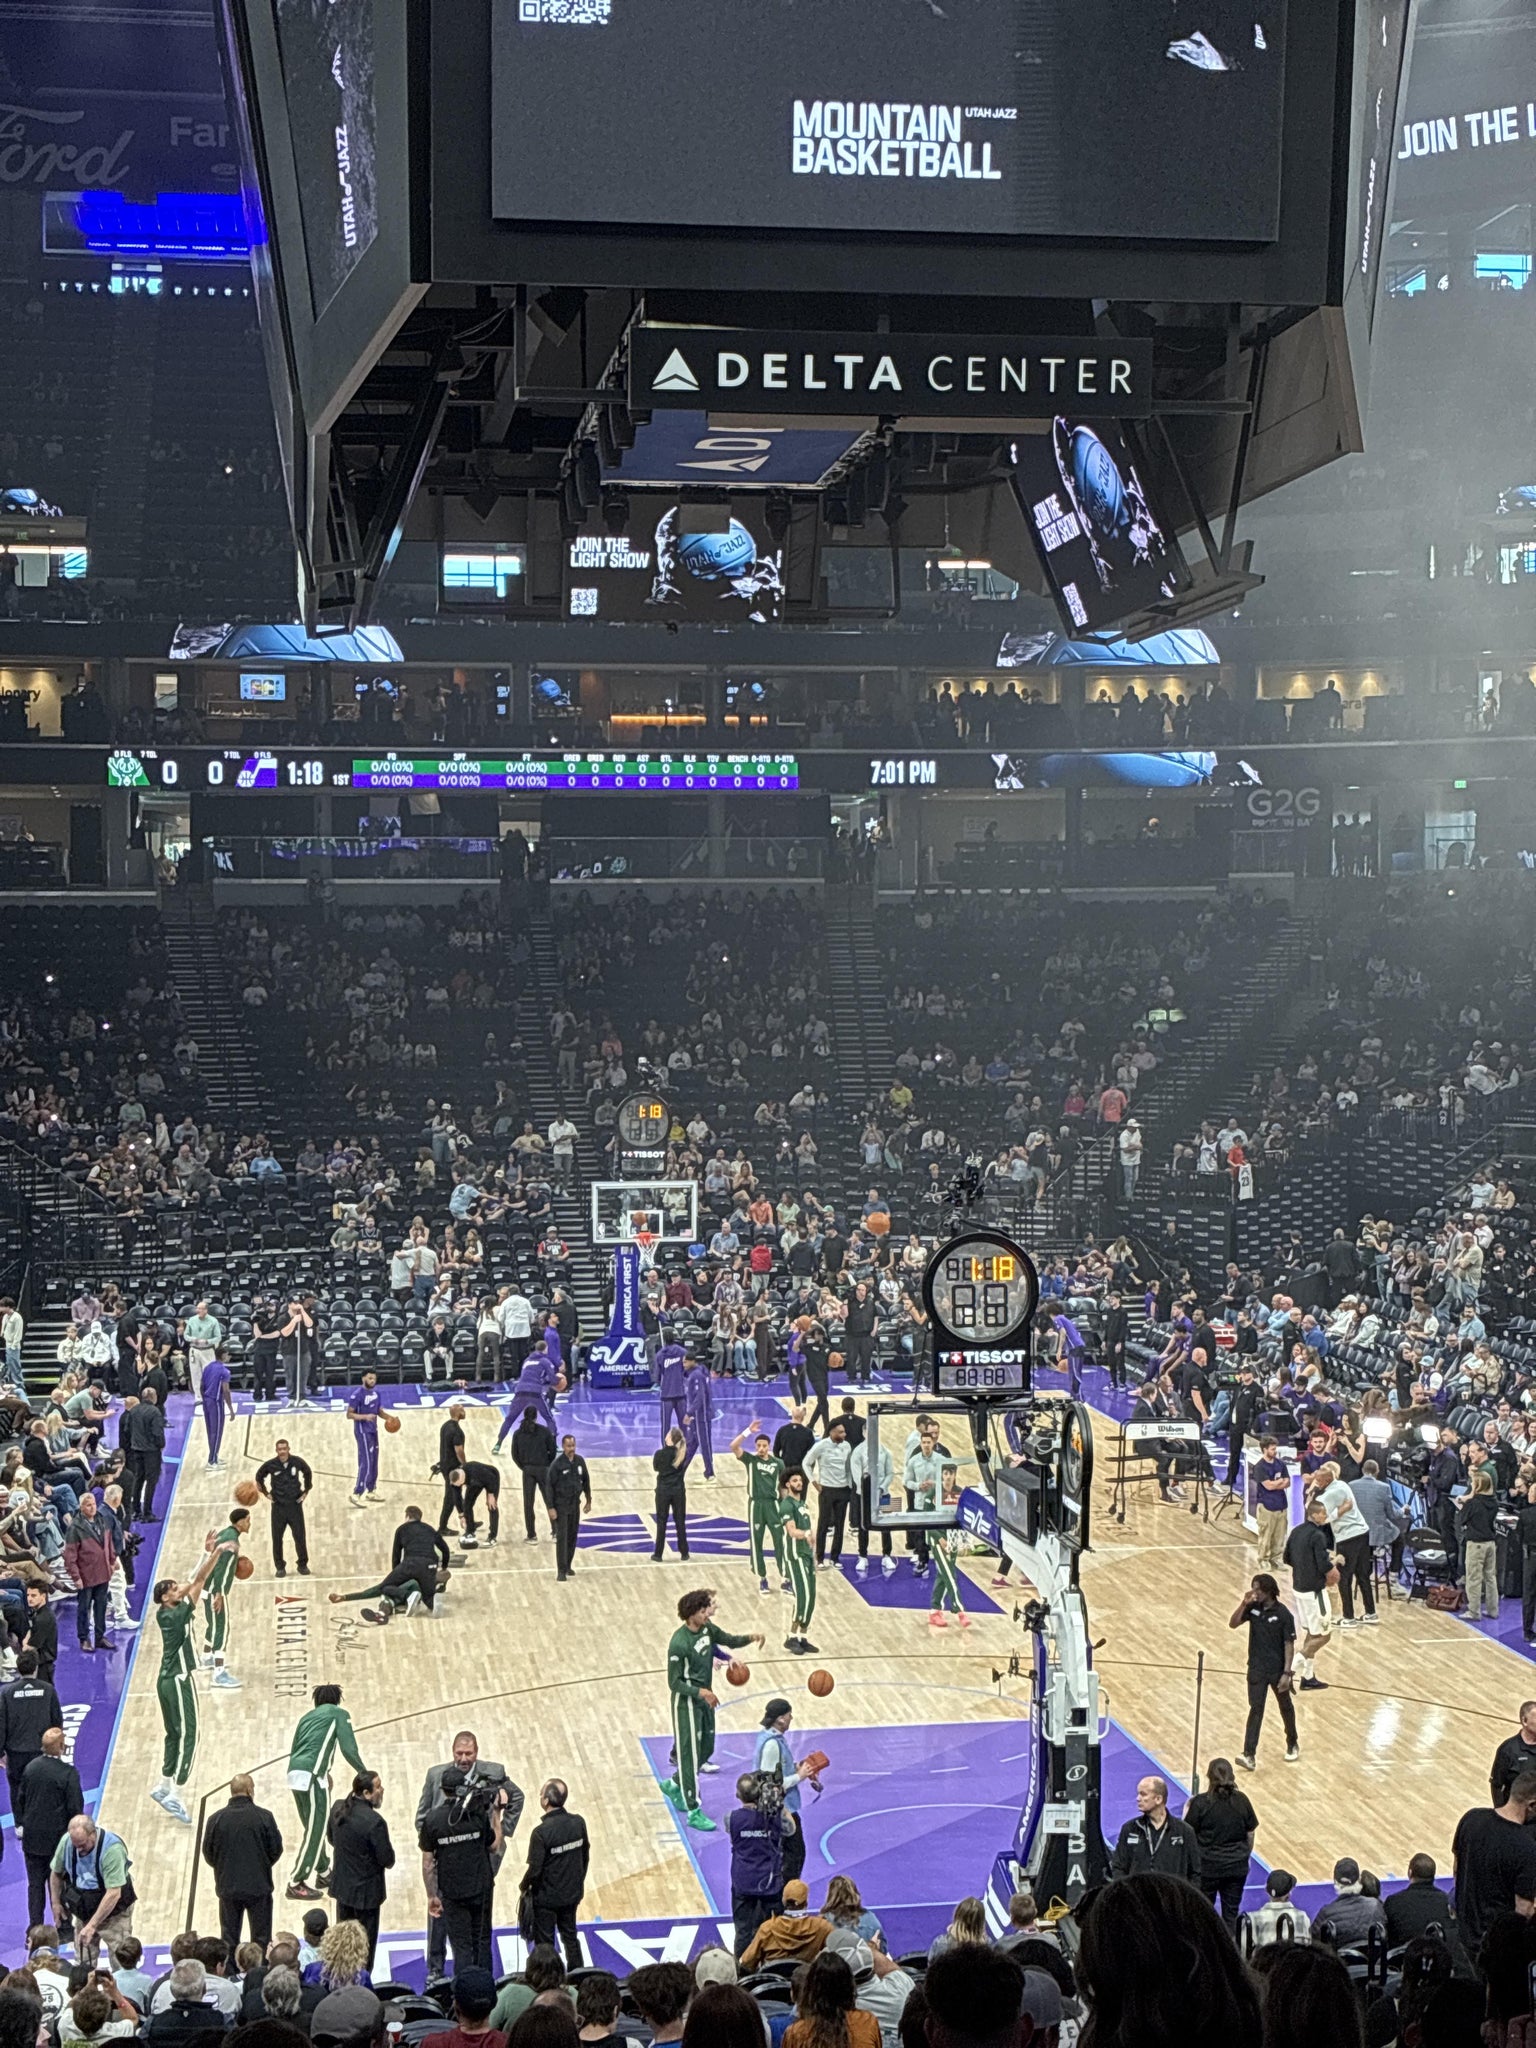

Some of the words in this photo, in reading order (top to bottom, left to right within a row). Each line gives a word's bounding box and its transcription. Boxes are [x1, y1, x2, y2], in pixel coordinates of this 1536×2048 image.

[793, 100, 961, 142] MOUNTAIN
[964, 107, 992, 118] UTAH
[992, 108, 1017, 119] JAZZ
[1397, 116, 1458, 159] JOIN
[1464, 106, 1519, 147] THE
[335, 124, 351, 173] JAZZ
[792, 137, 1001, 179] BASKETBALL
[342, 195, 358, 247] UTAH
[717, 352, 902, 391] DELTA
[927, 356, 1132, 394] CENTER
[570, 537, 601, 553] JOIN
[604, 537, 630, 553] THE
[570, 552, 608, 568] LIGHT
[609, 552, 649, 568] SHOW
[371, 762, 390, 772] 0/0
[391, 762, 414, 773] (0%)
[439, 762, 457, 772] 0/0
[459, 762, 481, 773] (0%)
[506, 762, 525, 772] 0/0
[526, 762, 547, 773] (0%)
[568, 764, 576, 773] 0
[591, 764, 599, 773] 0
[615, 764, 623, 773] 0
[639, 764, 647, 773] 0
[662, 764, 670, 773] 0
[686, 764, 694, 773] 0
[709, 764, 717, 773] 0
[733, 764, 741, 773] 0
[757, 764, 765, 773] 0
[780, 764, 788, 773] 0
[522, 754, 531, 762] FT
[637, 754, 650, 763] AST
[660, 754, 672, 763] STL
[162, 760, 177, 784] 0
[208, 760, 223, 784] 0
[287, 761, 324, 785] 1:18
[333, 774, 350, 786] 1ST
[371, 775, 390, 785] 0/0
[391, 775, 414, 786] (0%)
[439, 775, 457, 785] 0/0
[459, 775, 481, 786] (0%)
[506, 775, 525, 785] 0/0
[526, 775, 547, 786] (0%)
[568, 777, 576, 787] 0
[591, 777, 599, 787] 0
[615, 777, 623, 787] 0
[639, 777, 647, 787] 0
[662, 777, 670, 787] 0
[686, 777, 694, 787] 0
[709, 777, 717, 787] 0
[733, 777, 741, 787] 0
[757, 777, 765, 787] 0
[780, 777, 788, 787] 0
[870, 760, 904, 784] 7:01
[909, 760, 936, 784] PM
[1247, 788, 1320, 816] G2G
[639, 1104, 662, 1119] 1:18
[633, 1151, 665, 1159] TISSOT
[623, 1257, 632, 1285] FIRST
[971, 1255, 1014, 1281] 1:18
[623, 1286, 632, 1331] AMERICA
[599, 1364, 633, 1372] AMERICA
[634, 1364, 649, 1372] FIRS
[963, 1351, 1026, 1364] TISSOT
[1158, 1425, 1184, 1433] Wilson
[276, 1606, 307, 1645] DELTA
[274, 1649, 308, 1698] CENTER
[1019, 1742, 1037, 1845] AMERICA
